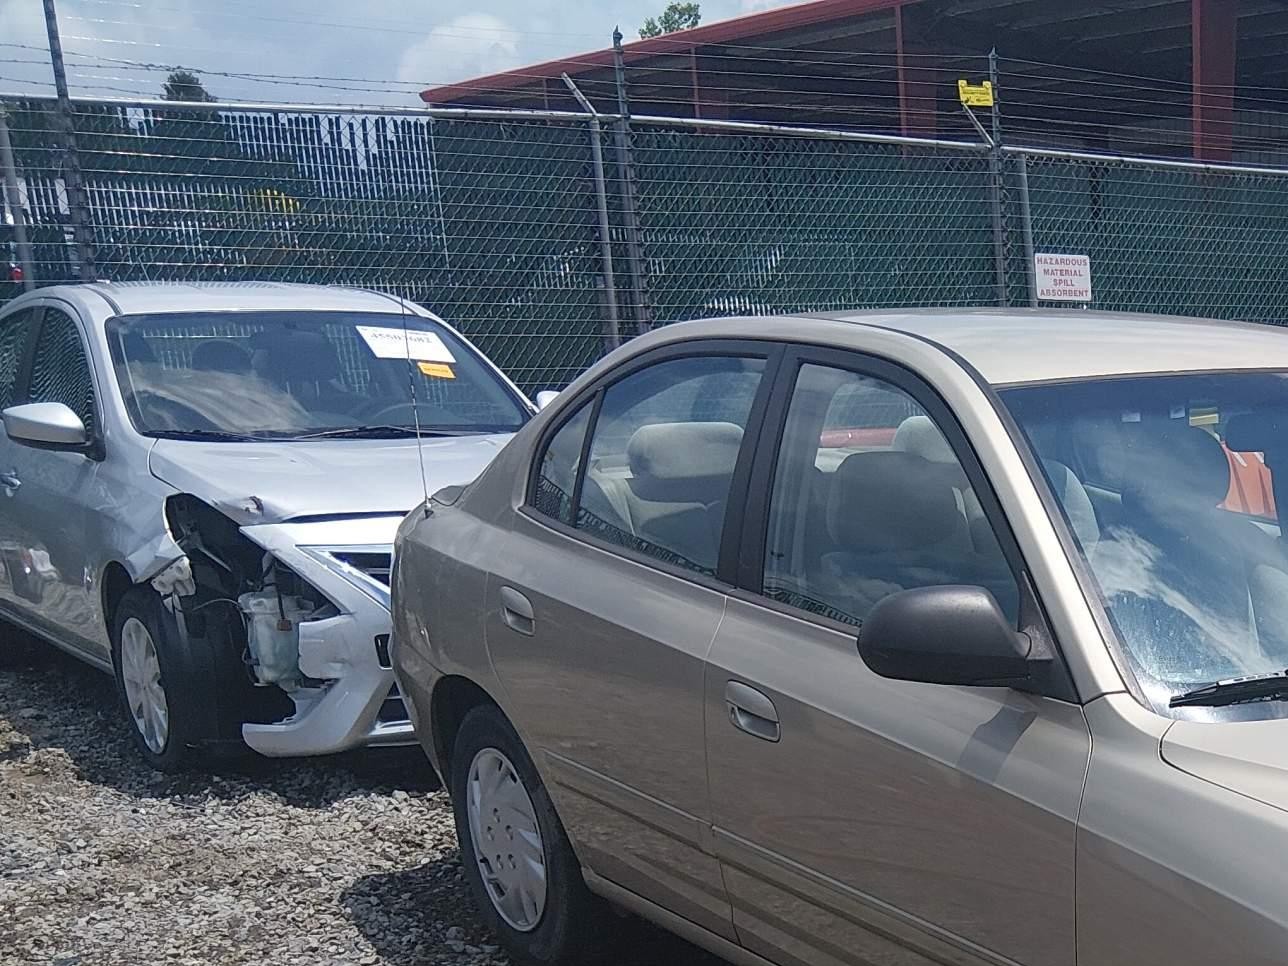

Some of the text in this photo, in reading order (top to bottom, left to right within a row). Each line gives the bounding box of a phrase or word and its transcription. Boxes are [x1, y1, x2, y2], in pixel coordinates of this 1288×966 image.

[1036, 256, 1088, 267] HAZARDOUS
[1043, 268, 1083, 277] MATERIAL
[1052, 278, 1075, 287] SPILL
[1040, 288, 1089, 297] ABSORBENT
